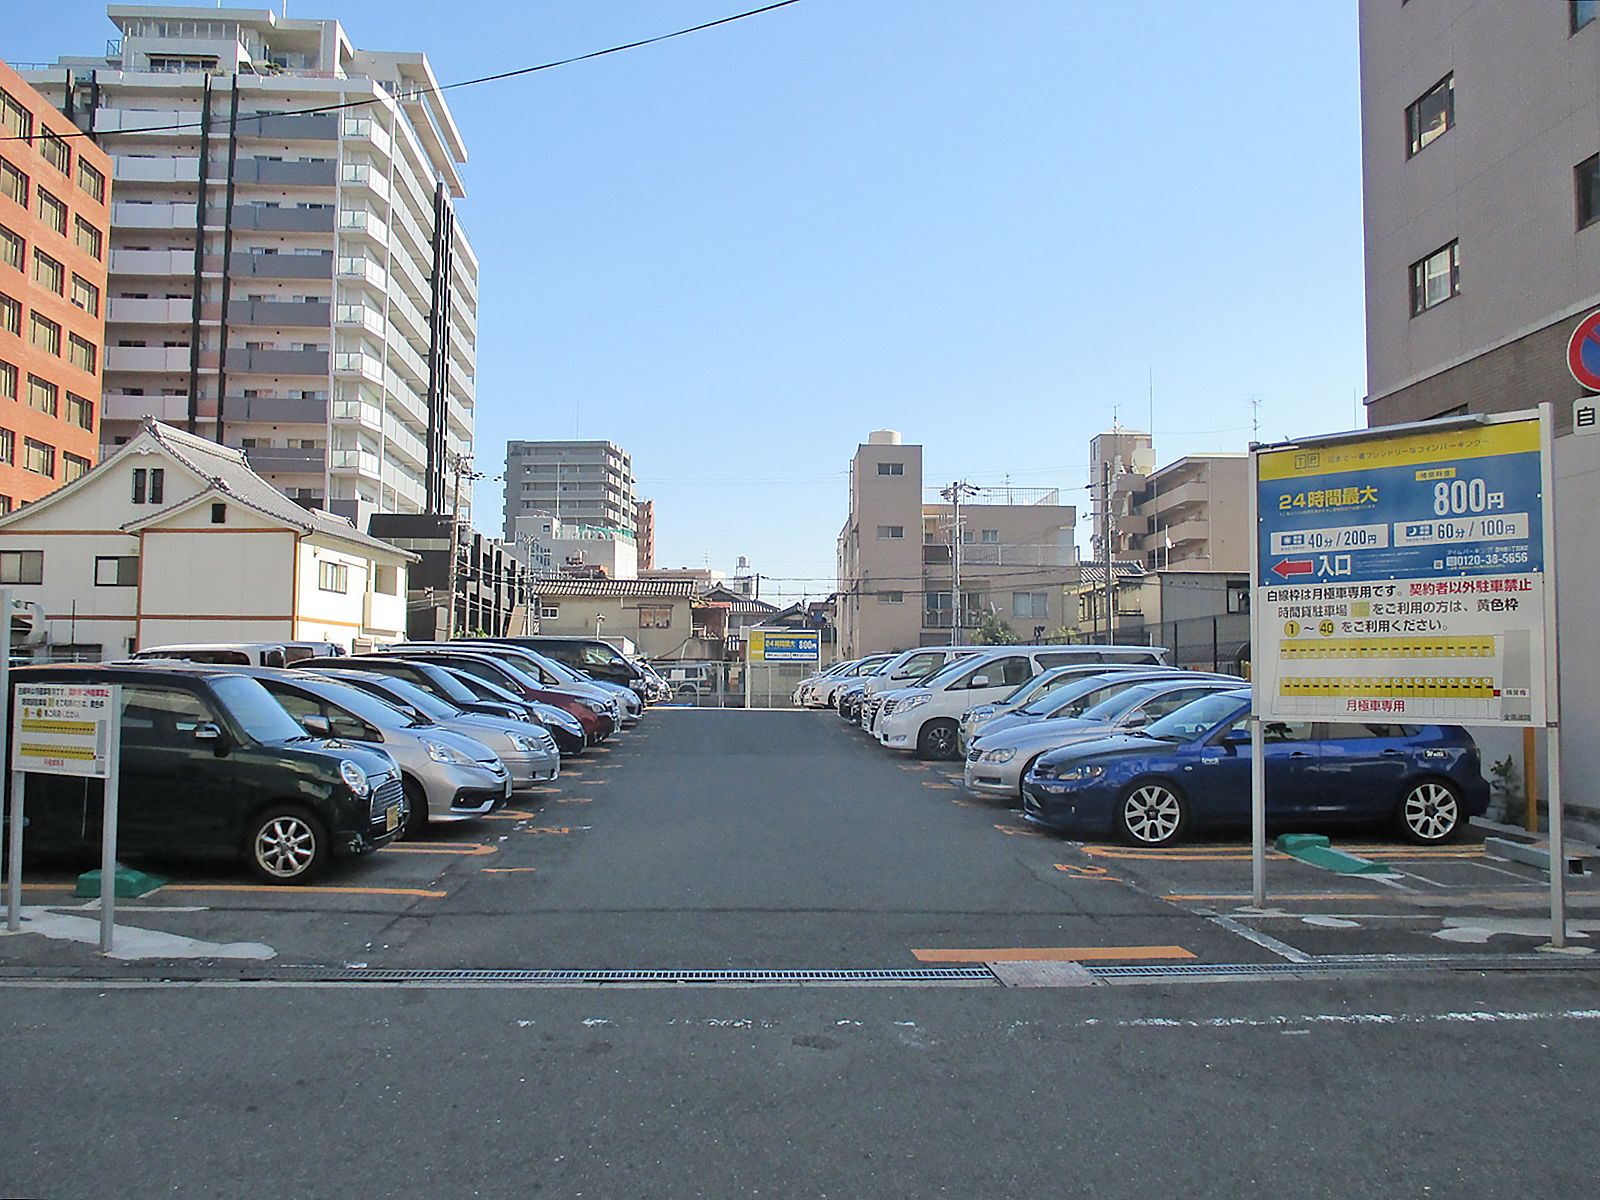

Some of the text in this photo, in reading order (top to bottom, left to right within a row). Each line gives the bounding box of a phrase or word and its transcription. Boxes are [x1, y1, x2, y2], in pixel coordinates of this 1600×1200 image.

[1279, 485, 1378, 510] 24時間最大
[1434, 478, 1505, 516] 800円
[1317, 554, 1351, 577] 入口
[1346, 699, 1405, 713] 月極車専用
